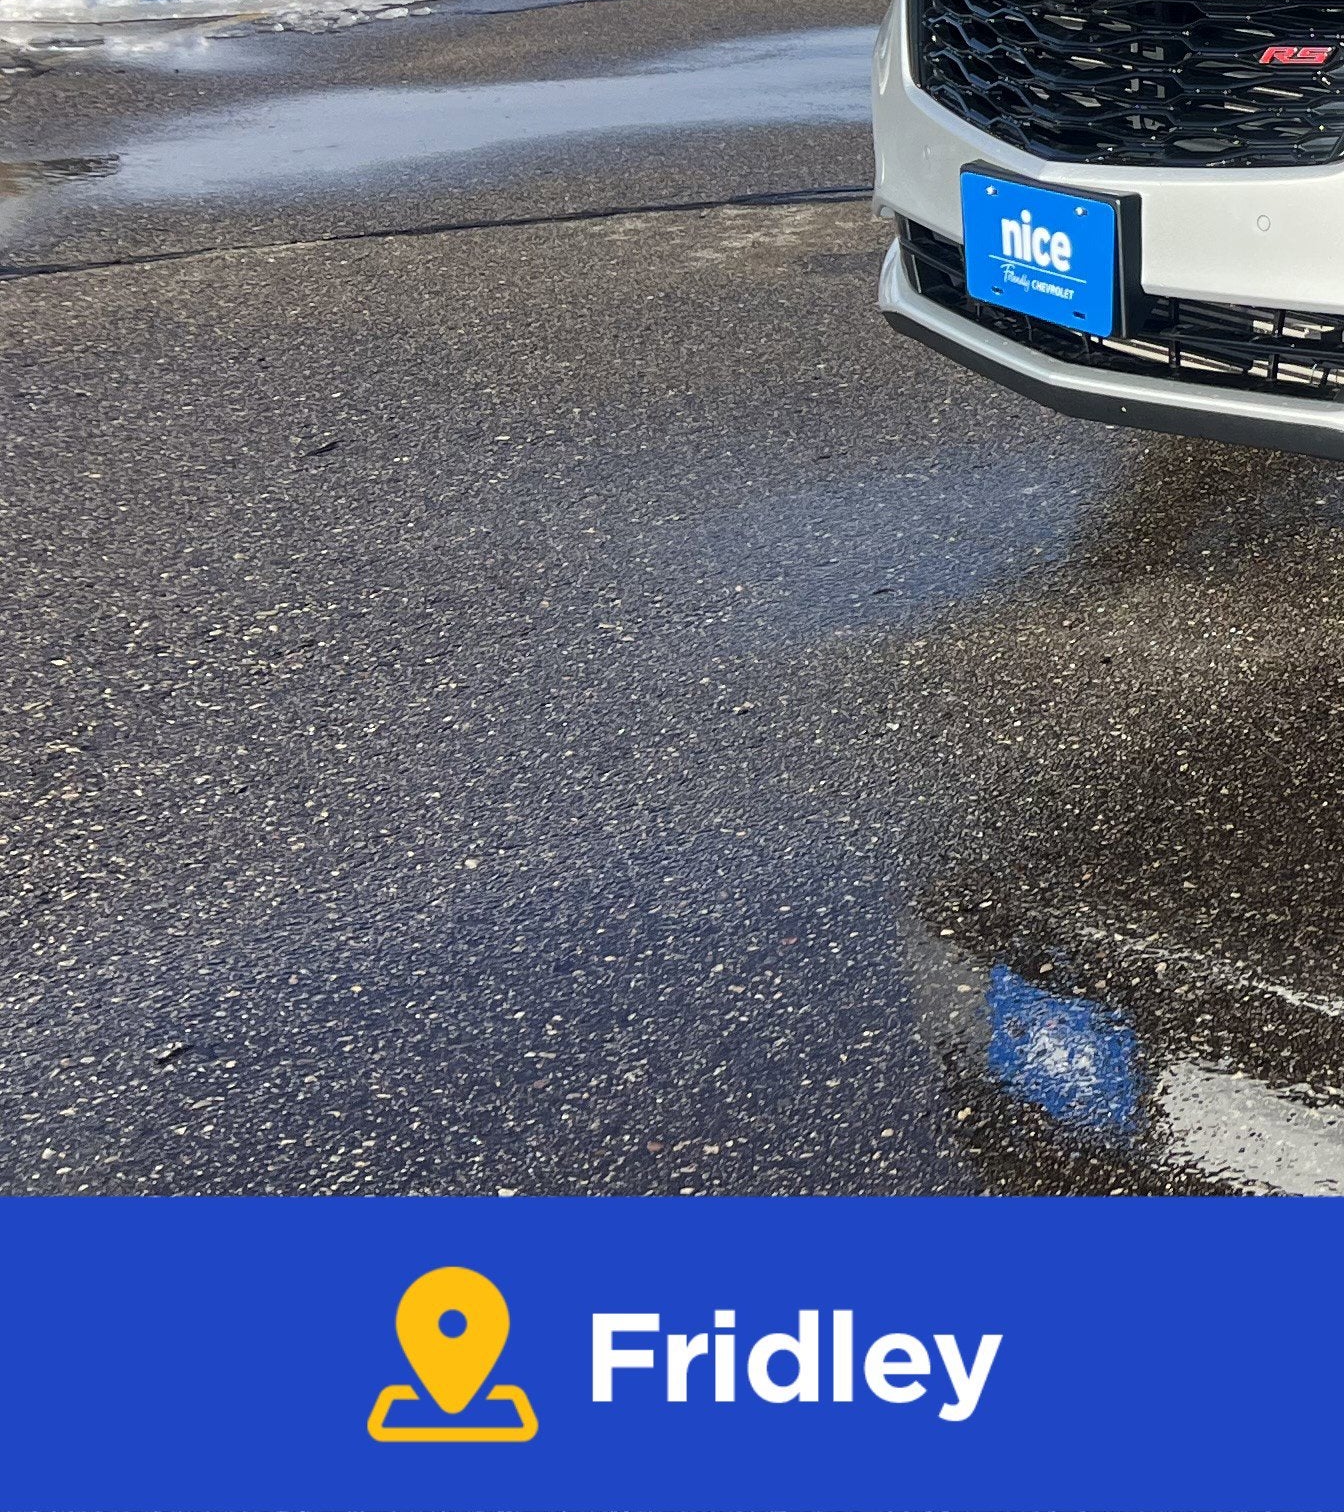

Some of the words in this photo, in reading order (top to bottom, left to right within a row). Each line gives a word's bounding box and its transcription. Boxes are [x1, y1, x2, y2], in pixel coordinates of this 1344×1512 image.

[1258, 46, 1334, 65] RS
[1001, 209, 1073, 272] nice
[1000, 263, 1031, 292] Friendly
[1031, 279, 1075, 300] CHEVROLET
